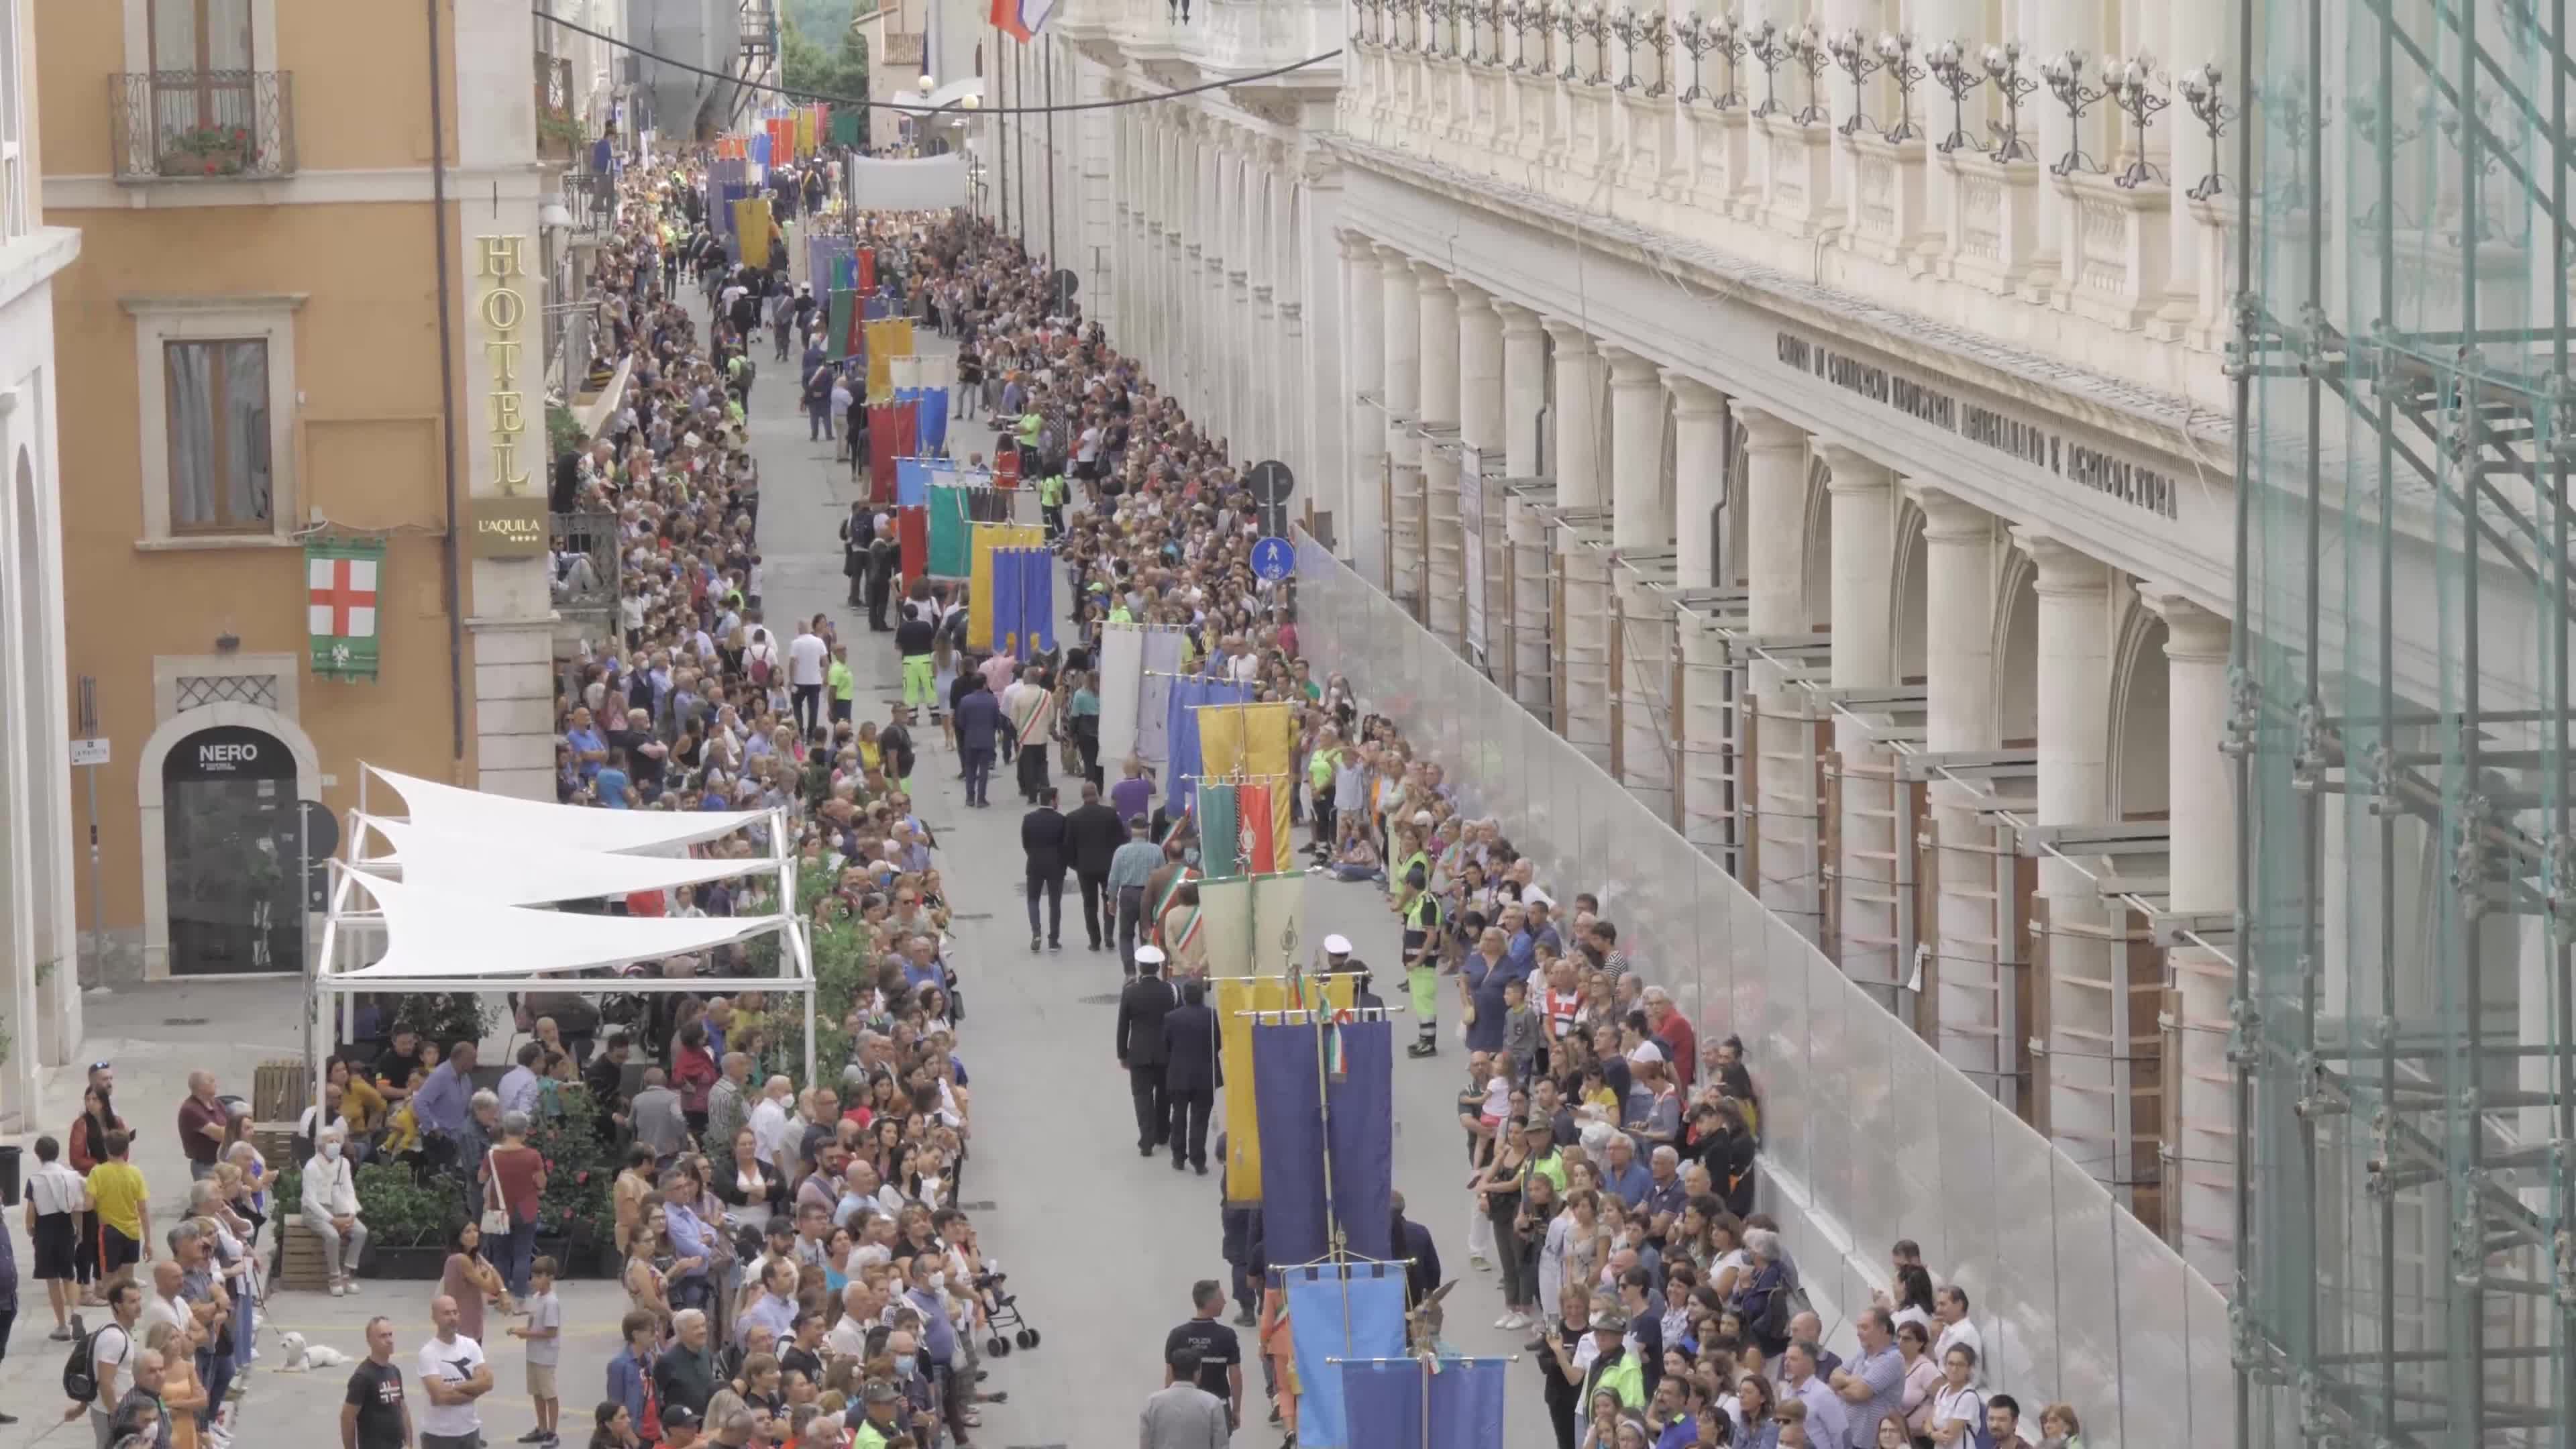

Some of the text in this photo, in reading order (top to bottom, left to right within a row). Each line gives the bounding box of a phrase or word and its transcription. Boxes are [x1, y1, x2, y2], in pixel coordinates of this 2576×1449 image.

[474, 235, 531, 484] HOTEL
[478, 519, 541, 535] L'AQUILA
[199, 744, 258, 762] NERO
